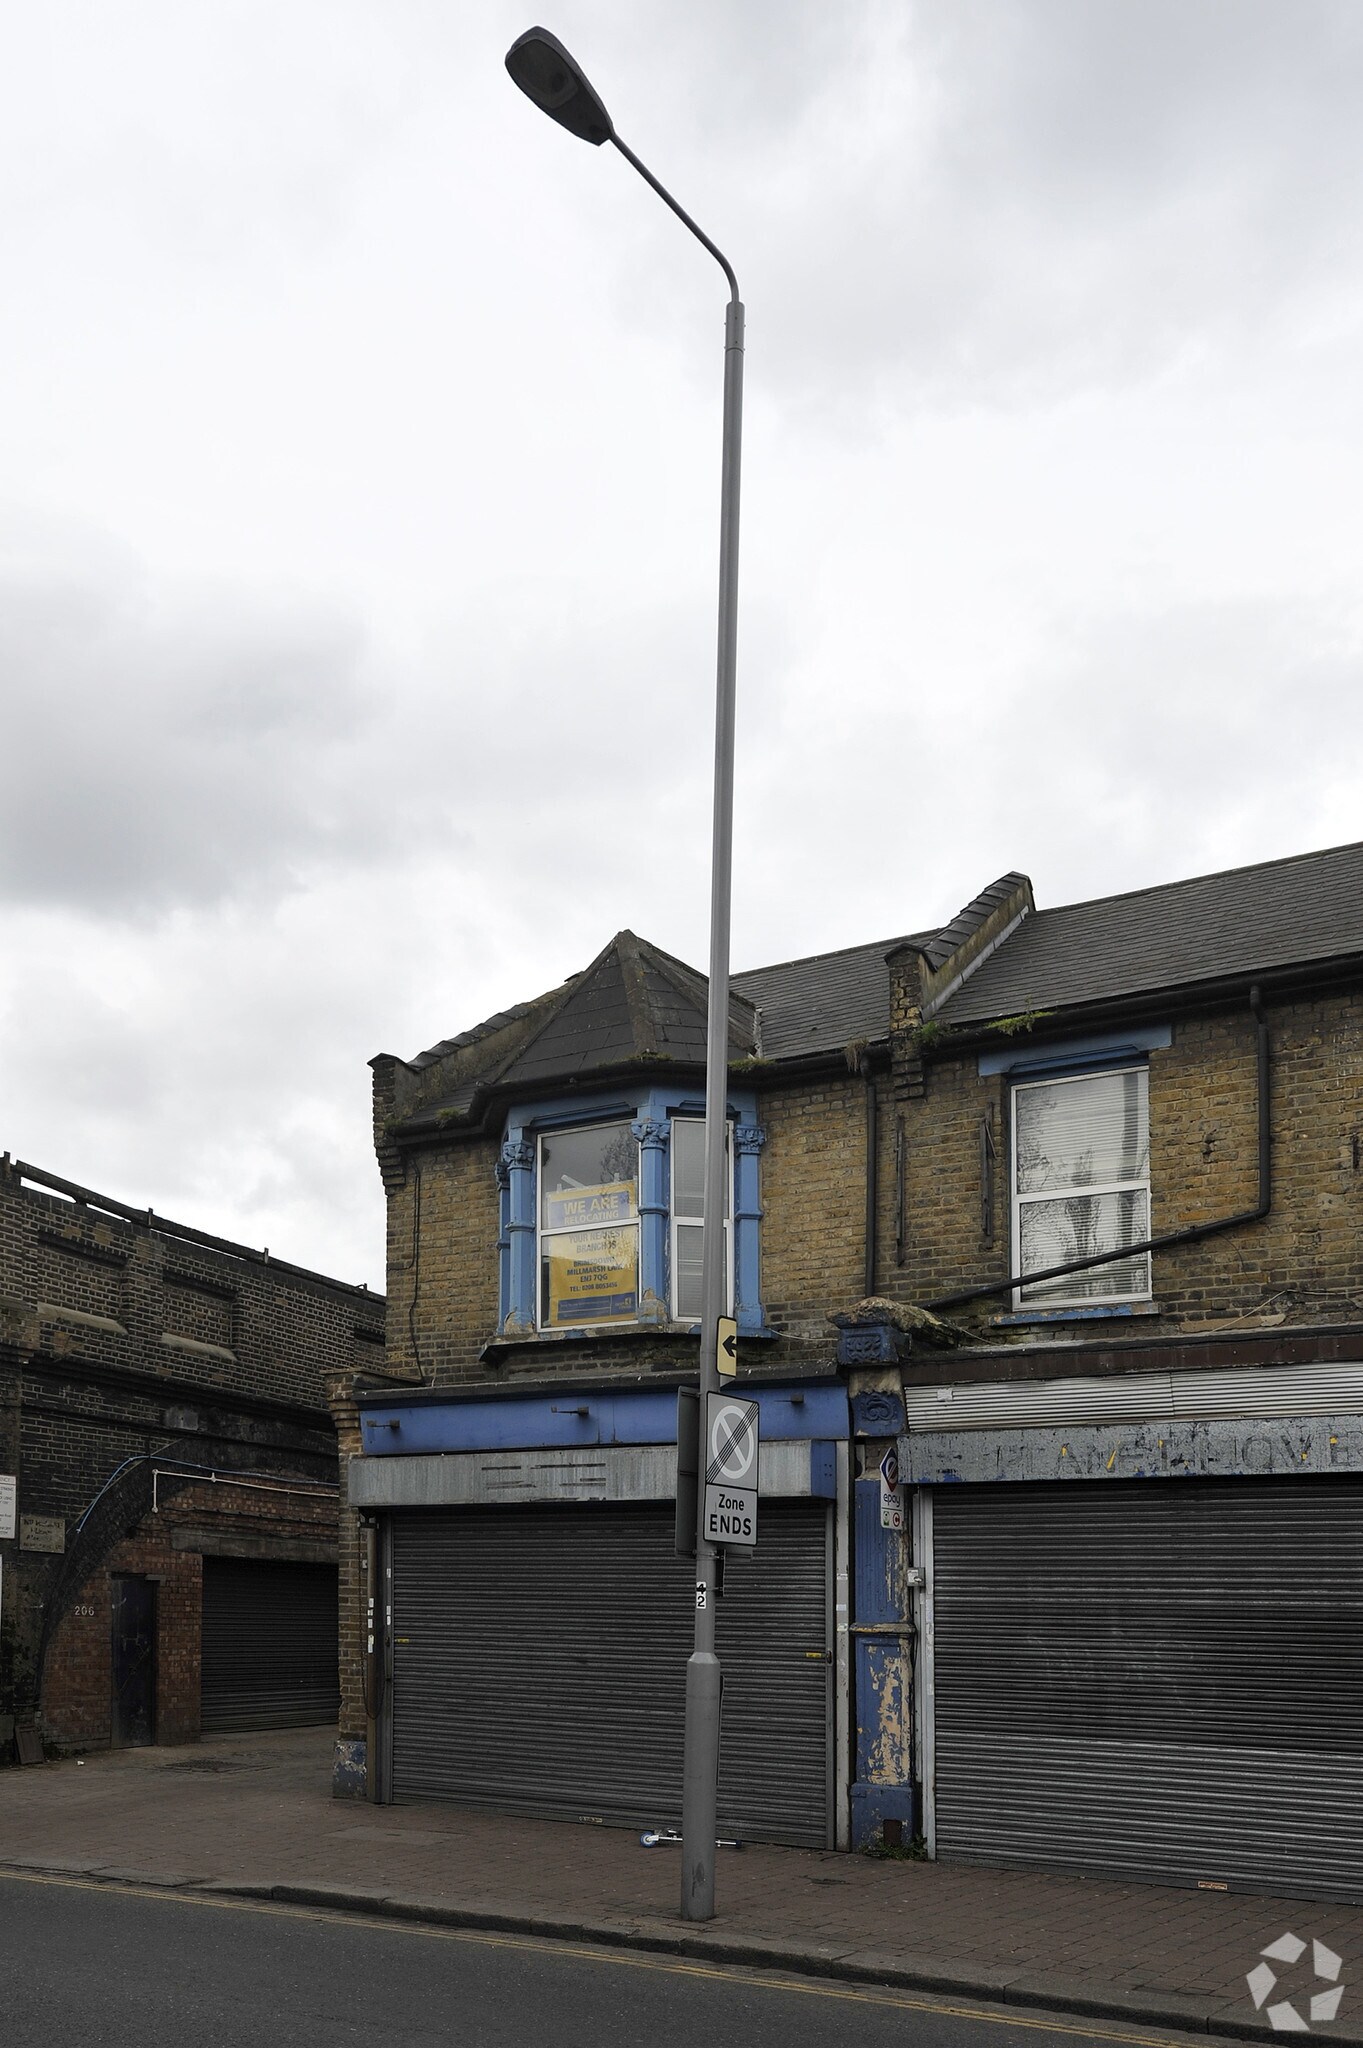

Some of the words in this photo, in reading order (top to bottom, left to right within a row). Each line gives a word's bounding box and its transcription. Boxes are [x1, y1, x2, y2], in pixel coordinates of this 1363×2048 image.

[564, 1200, 586, 1215] WE
[591, 1195, 619, 1211] ARE
[564, 1210, 619, 1225] RELOCATING
[569, 1232, 589, 1244] YOUR
[576, 1241, 606, 1254] BRANCH
[567, 1265, 606, 1276] MILLMARSH
[593, 1273, 608, 1282] 7QG
[718, 1493, 745, 1511] Zone
[883, 1493, 901, 1508] epay
[709, 1514, 752, 1537] ENDS
[74, 1605, 95, 1616] 206
